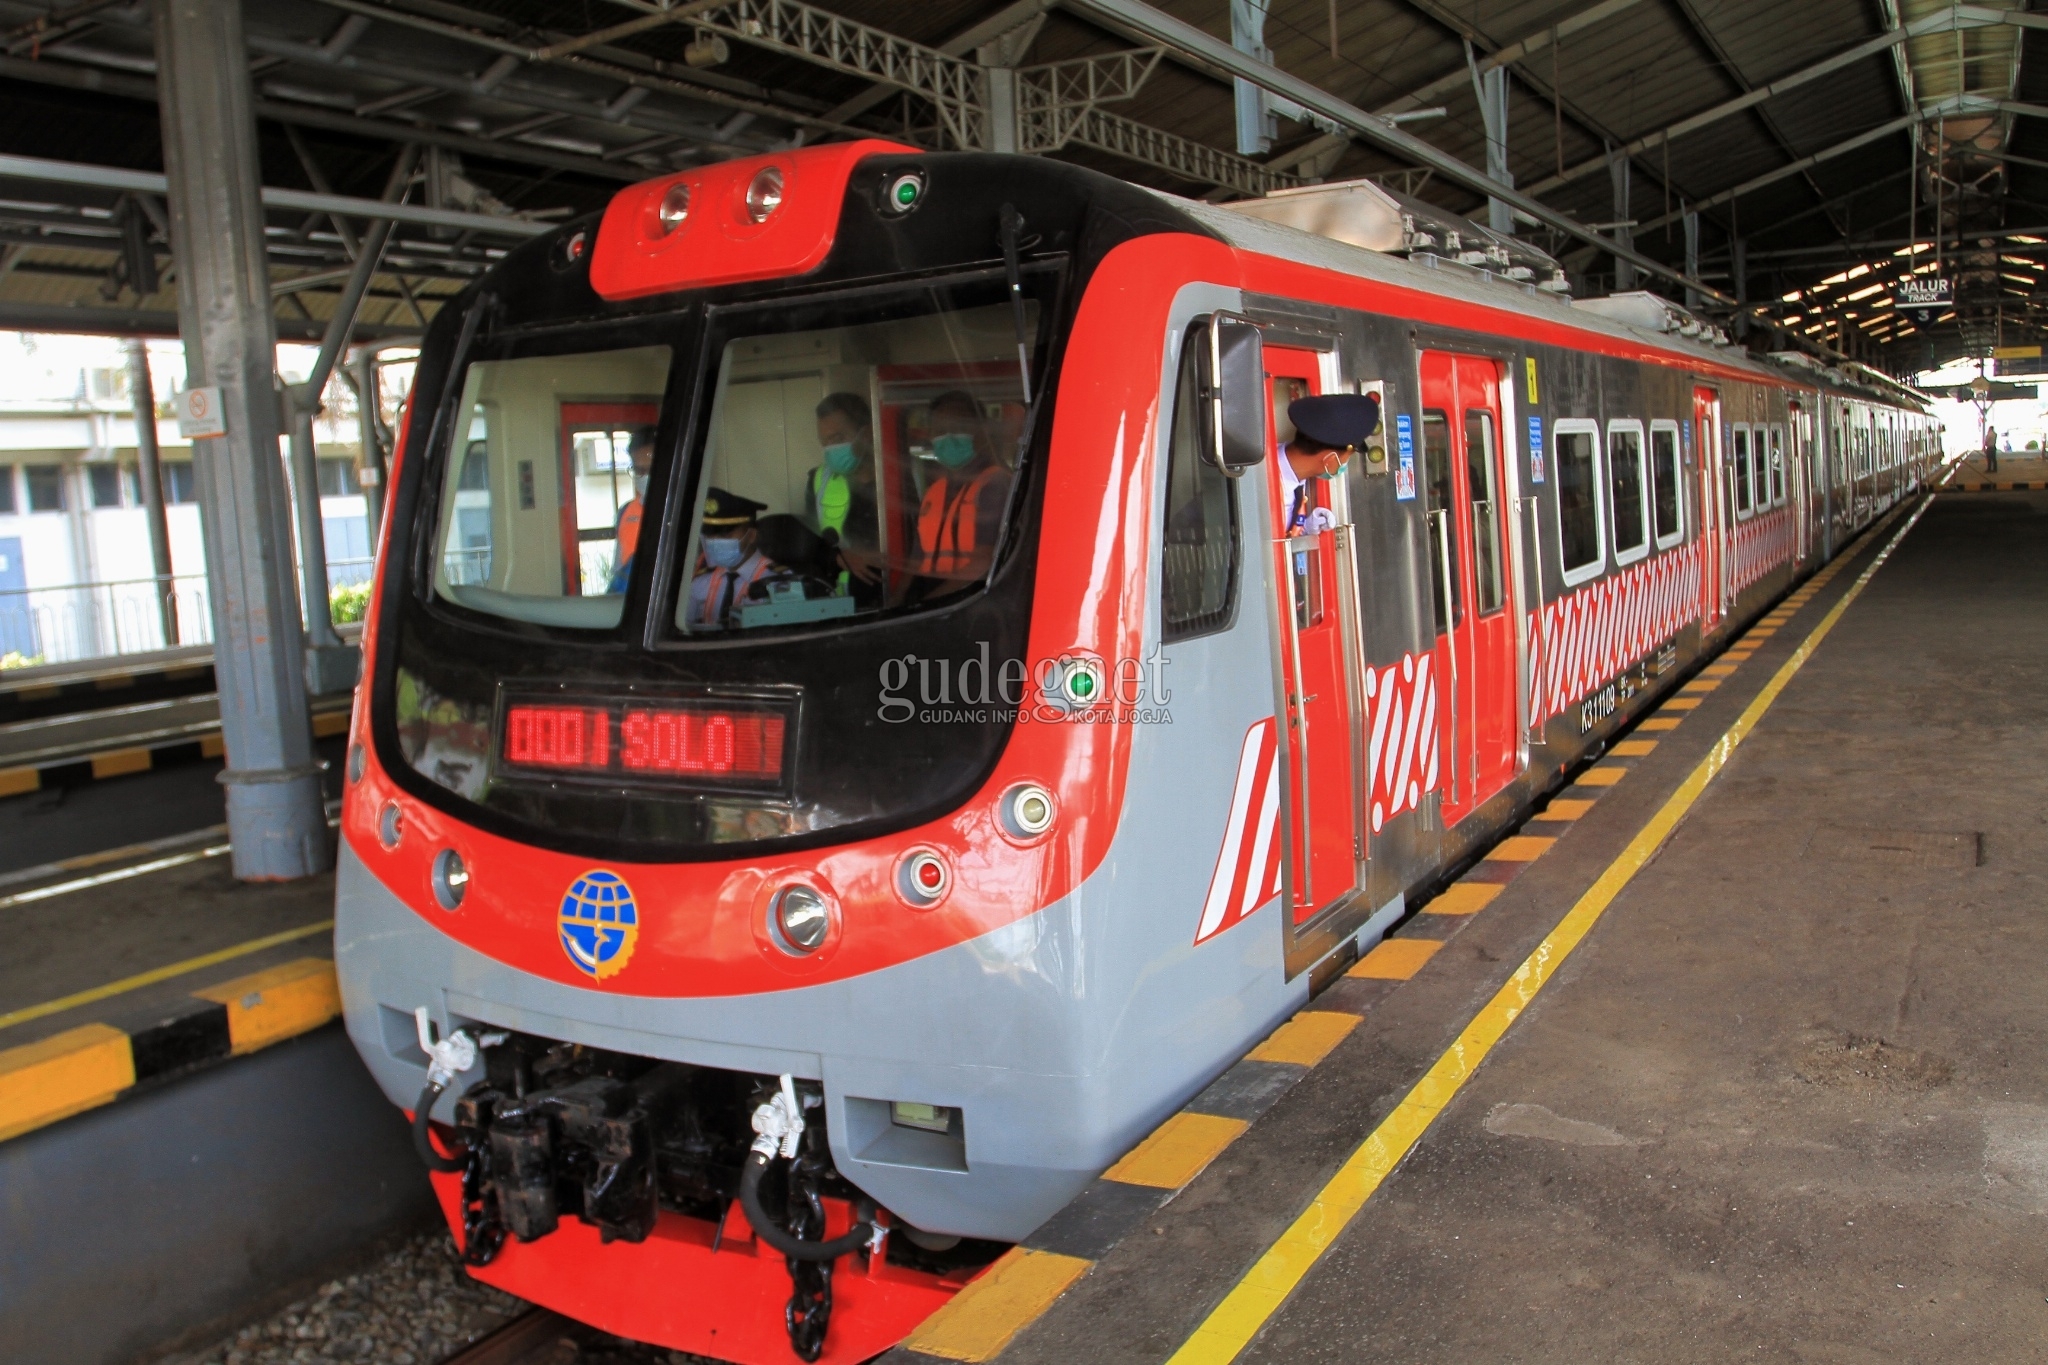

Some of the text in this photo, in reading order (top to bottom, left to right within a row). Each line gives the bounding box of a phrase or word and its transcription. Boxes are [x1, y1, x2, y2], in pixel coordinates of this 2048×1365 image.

[1900, 279, 1948, 295] JALUR
[1908, 292, 1938, 302] TRACK
[1918, 309, 1929, 321] 3
[622, 713, 734, 772] SOLO
